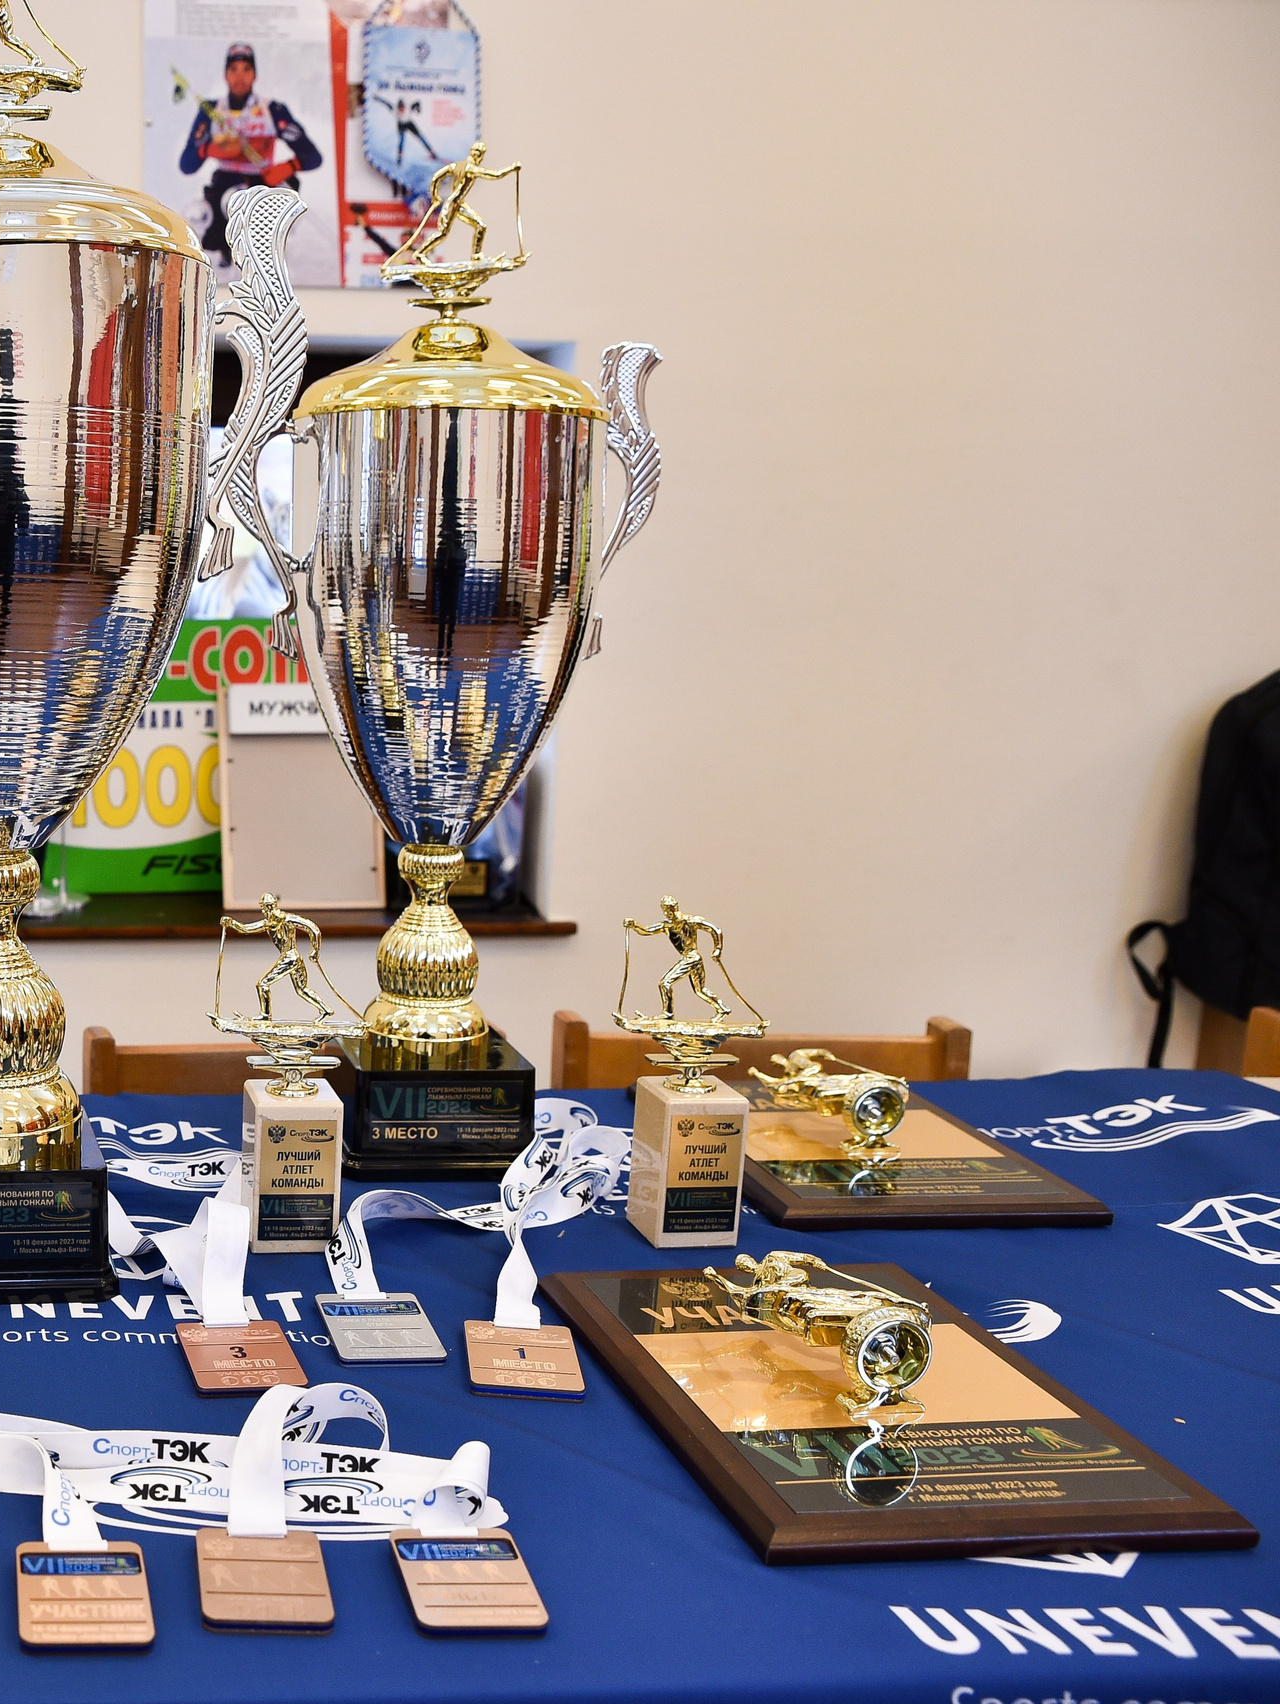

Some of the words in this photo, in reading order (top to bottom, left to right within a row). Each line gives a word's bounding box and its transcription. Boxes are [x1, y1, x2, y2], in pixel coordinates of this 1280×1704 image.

[249, 701, 319, 717] МУЖЧИ
[375, 1087, 426, 1119] VII
[427, 1101, 470, 1113] 2023
[89, 1116, 229, 1146] ТЭК
[372, 1127, 380, 1139] 3
[385, 1127, 438, 1140] МЕСТО
[684, 1143, 727, 1155] ЛУЧШИЙ
[276, 1149, 321, 1162] ЛУЧШИЙ
[689, 1158, 720, 1168] АТЛЕТ
[282, 1165, 314, 1174] АТЛЕТ
[678, 1171, 729, 1182] КОМАНДЫ
[271, 1178, 324, 1188] КОМАНДЫ
[42, 1190, 54, 1198] ПО
[640, 1305, 750, 1329] УЧА
[229, 1346, 247, 1358] 3
[512, 1347, 526, 1359] 1
[213, 1359, 277, 1369] МЕСТО
[492, 1358, 556, 1371] МЕСТО
[992, 1426, 1021, 1436] ПО
[877, 1437, 962, 1449] ЛЫЖНЫМ
[964, 1435, 1033, 1445] ГОНКАМ
[887, 1447, 1007, 1466] 2023
[935, 1482, 992, 1493] февраля
[994, 1480, 1023, 1489] 2023
[1026, 1479, 1058, 1490] года
[921, 1492, 970, 1502] Москва
[23, 1557, 64, 1574] VII
